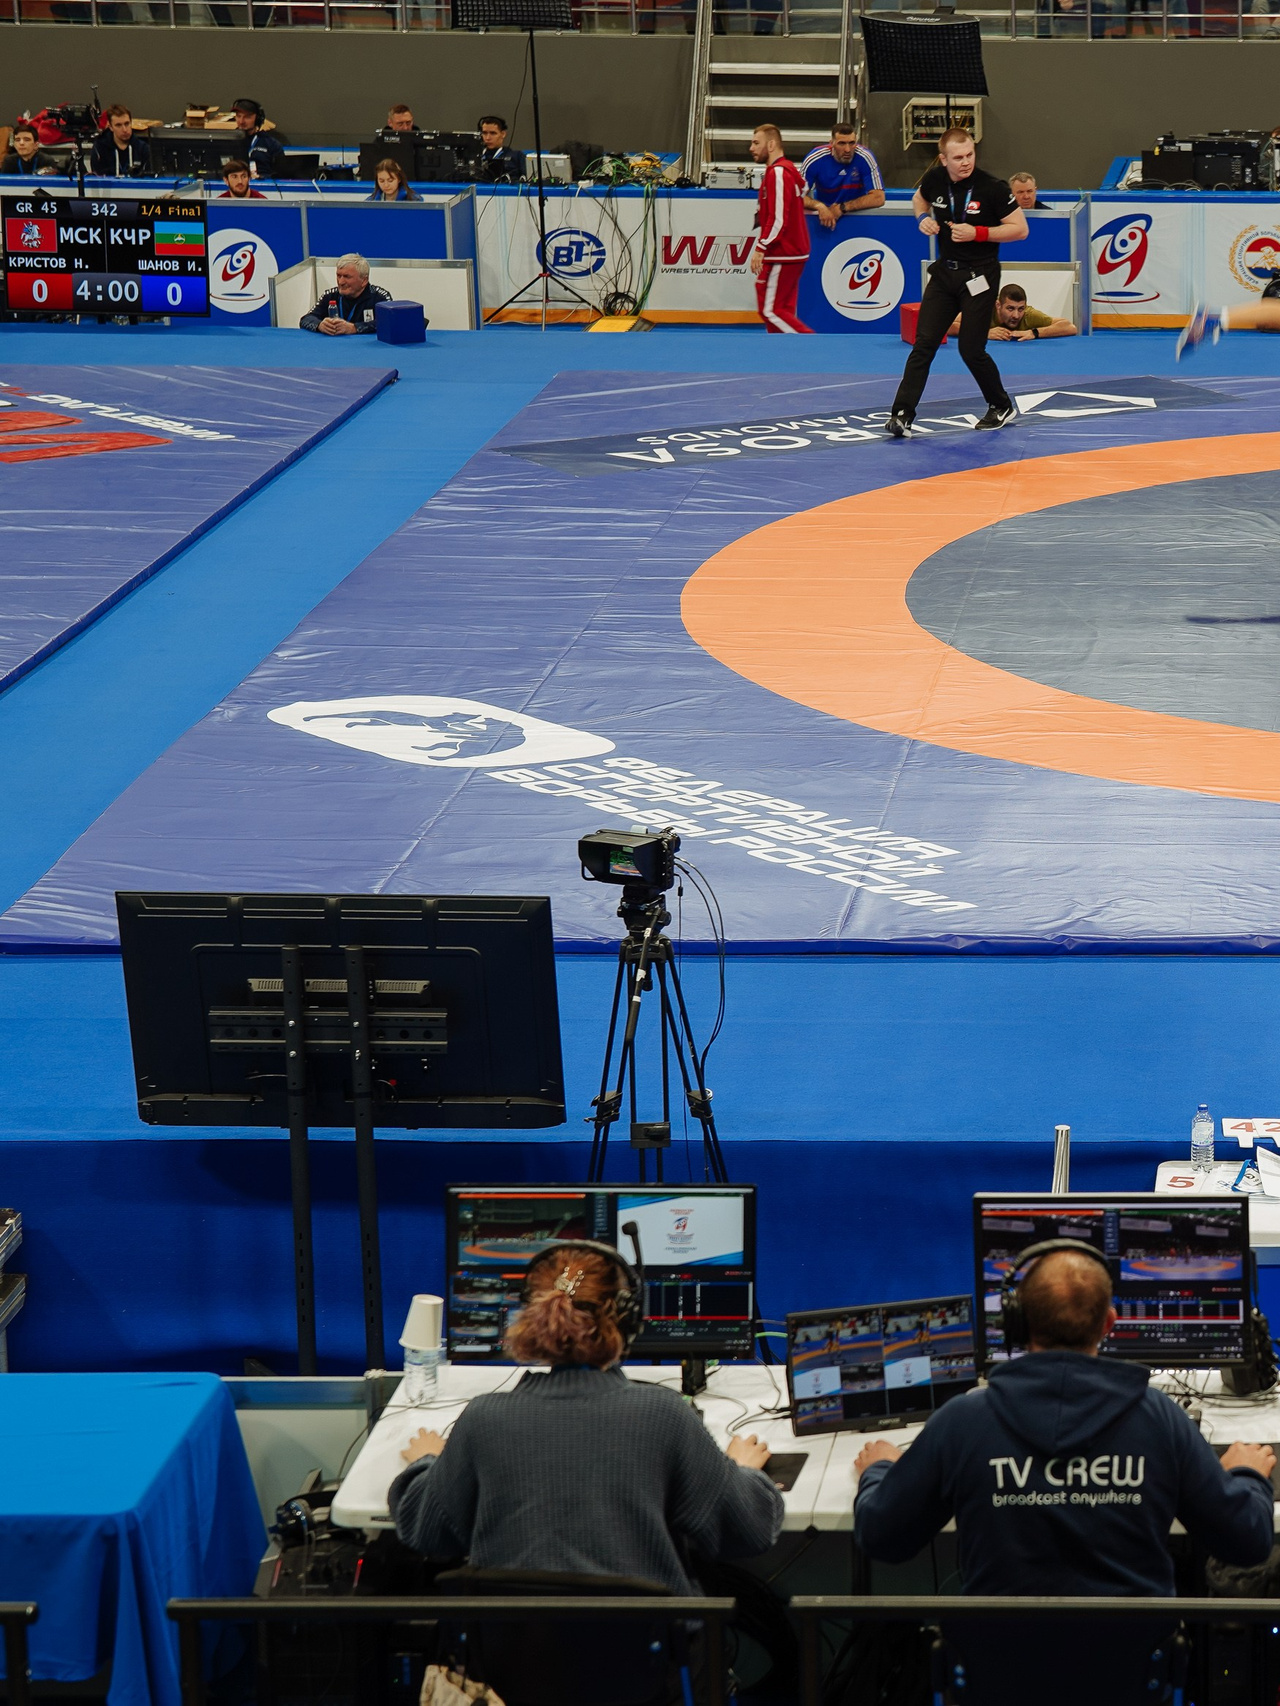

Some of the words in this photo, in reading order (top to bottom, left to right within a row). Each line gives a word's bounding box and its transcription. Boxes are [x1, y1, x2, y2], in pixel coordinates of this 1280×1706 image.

[16, 203, 33, 213] GR
[41, 203, 57, 213] 45
[91, 203, 118, 216] 342
[141, 205, 162, 216] 1/4
[168, 206, 201, 216] Final
[59, 226, 102, 245] МСК
[110, 228, 150, 245] КЧР
[9, 257, 66, 269] КРИСТОВ
[74, 258, 89, 269] Н.
[138, 259, 179, 271] ШАНОВ
[188, 260, 202, 272] И.
[661, 267, 747, 275] WRESTLINGTV.RU
[32, 279, 48, 303] 0
[76, 280, 139, 301] 4:00
[166, 282, 182, 306] 0
[602, 757, 962, 860] ФЕДЕРАЦИЯ
[542, 763, 946, 878] СПОРТИВНОЙ
[484, 768, 732, 838] БОРЬБЫ
[708, 835, 979, 912] РОССИИ
[1230, 1122, 1256, 1132] 4
[1167, 1176, 1195, 1188] 5
[988, 1456, 1034, 1489] TV
[1044, 1455, 1145, 1487] CREW
[992, 1490, 1067, 1507] broadcast
[1070, 1489, 1142, 1508] anywhere
